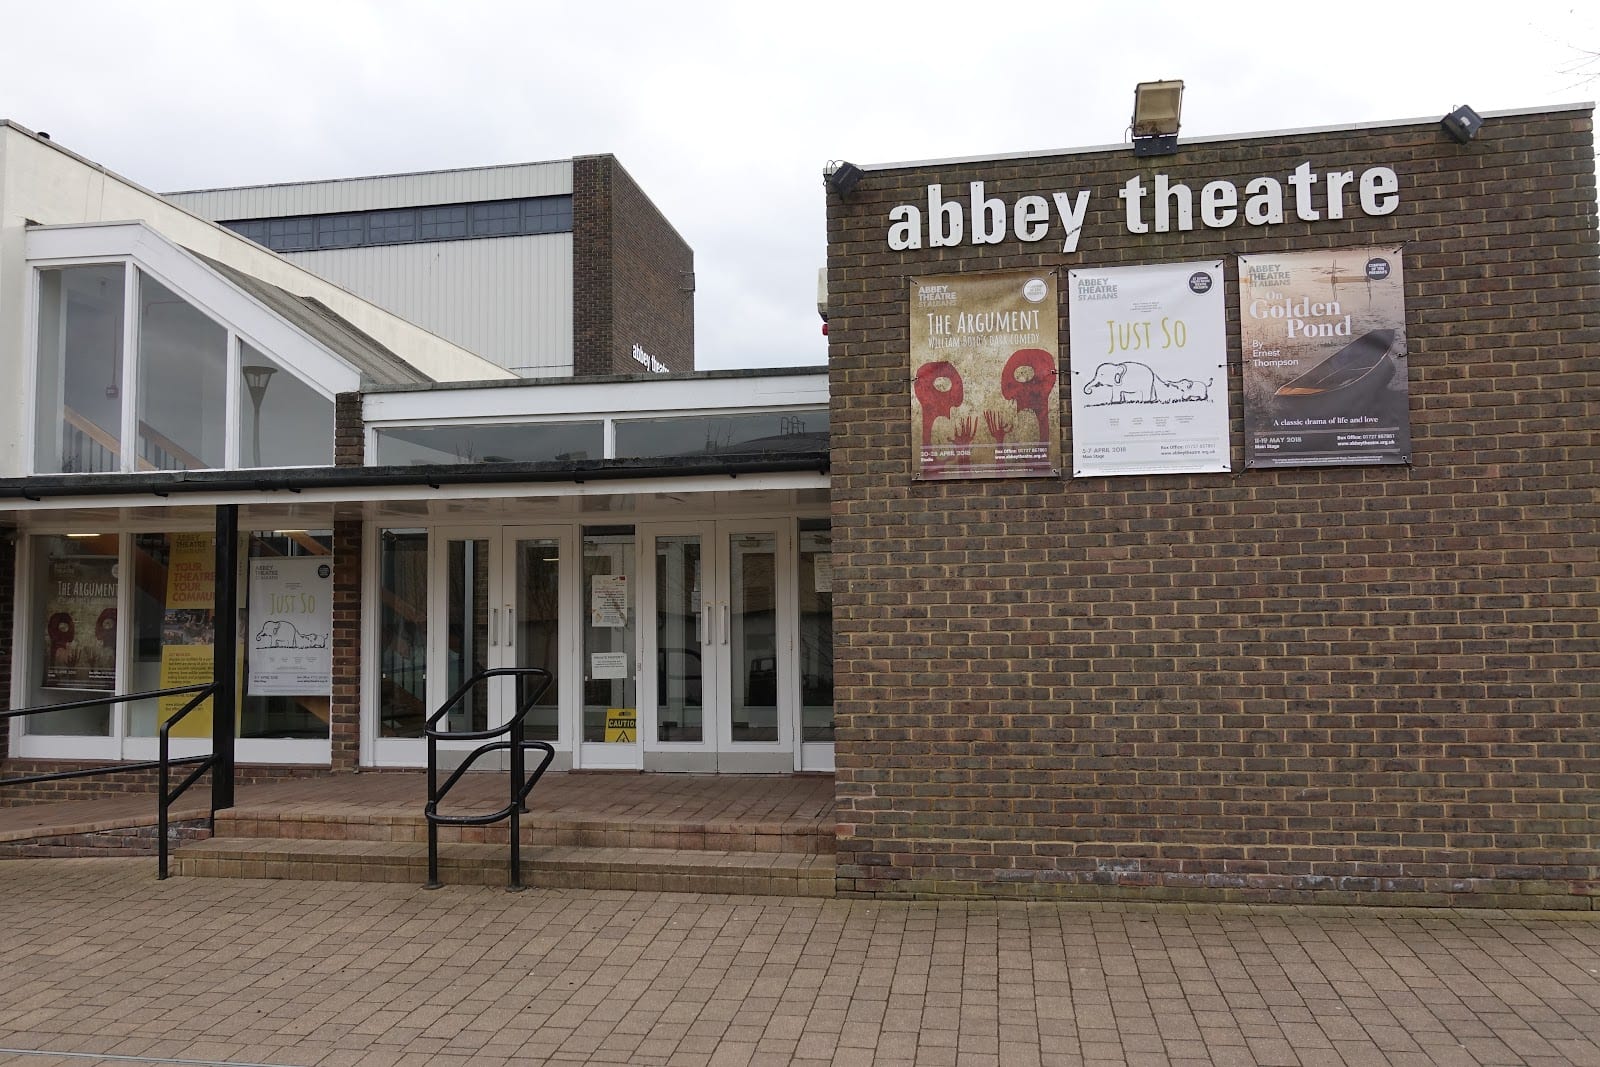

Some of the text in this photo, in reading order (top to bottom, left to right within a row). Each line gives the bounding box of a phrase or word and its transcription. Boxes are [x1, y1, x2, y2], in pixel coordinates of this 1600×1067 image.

[888, 161, 1399, 253] abbey theatre
[1249, 264, 1281, 273] ABBEY
[1249, 271, 1291, 281] THEATRE
[1078, 278, 1109, 287] ABBEY
[1258, 279, 1291, 287] ALBANS
[918, 285, 949, 294] ABBEY
[1078, 285, 1118, 294] THEATRE
[918, 292, 957, 301] THEATRE
[1087, 292, 1118, 301] ALBANS
[1266, 290, 1283, 301] On
[1250, 296, 1341, 319] Golden
[927, 310, 1040, 335] THE ARGUMENT
[1287, 314, 1352, 339] Pond
[1107, 317, 1187, 354] JUST SO
[928, 336, 960, 349] WILLIAM
[989, 334, 1008, 347] DARK
[1010, 333, 1040, 345] COMEDY
[1252, 339, 1264, 350] By
[632, 343, 650, 371] abbey
[1253, 350, 1281, 358] Ernest
[1253, 358, 1299, 368] Thompson
[1281, 418, 1303, 426] classic
[1337, 416, 1348, 424] life
[1349, 416, 1363, 424] and
[1364, 415, 1379, 423] love
[176, 541, 206, 549] THEATRE
[175, 562, 202, 572] YOUR
[173, 571, 215, 582] THEATRE
[58, 580, 71, 596] THE
[172, 582, 201, 592] YOUR
[172, 592, 215, 602] COMMU
[270, 592, 316, 615] JUST SO
[608, 719, 636, 728] CAUTIO
